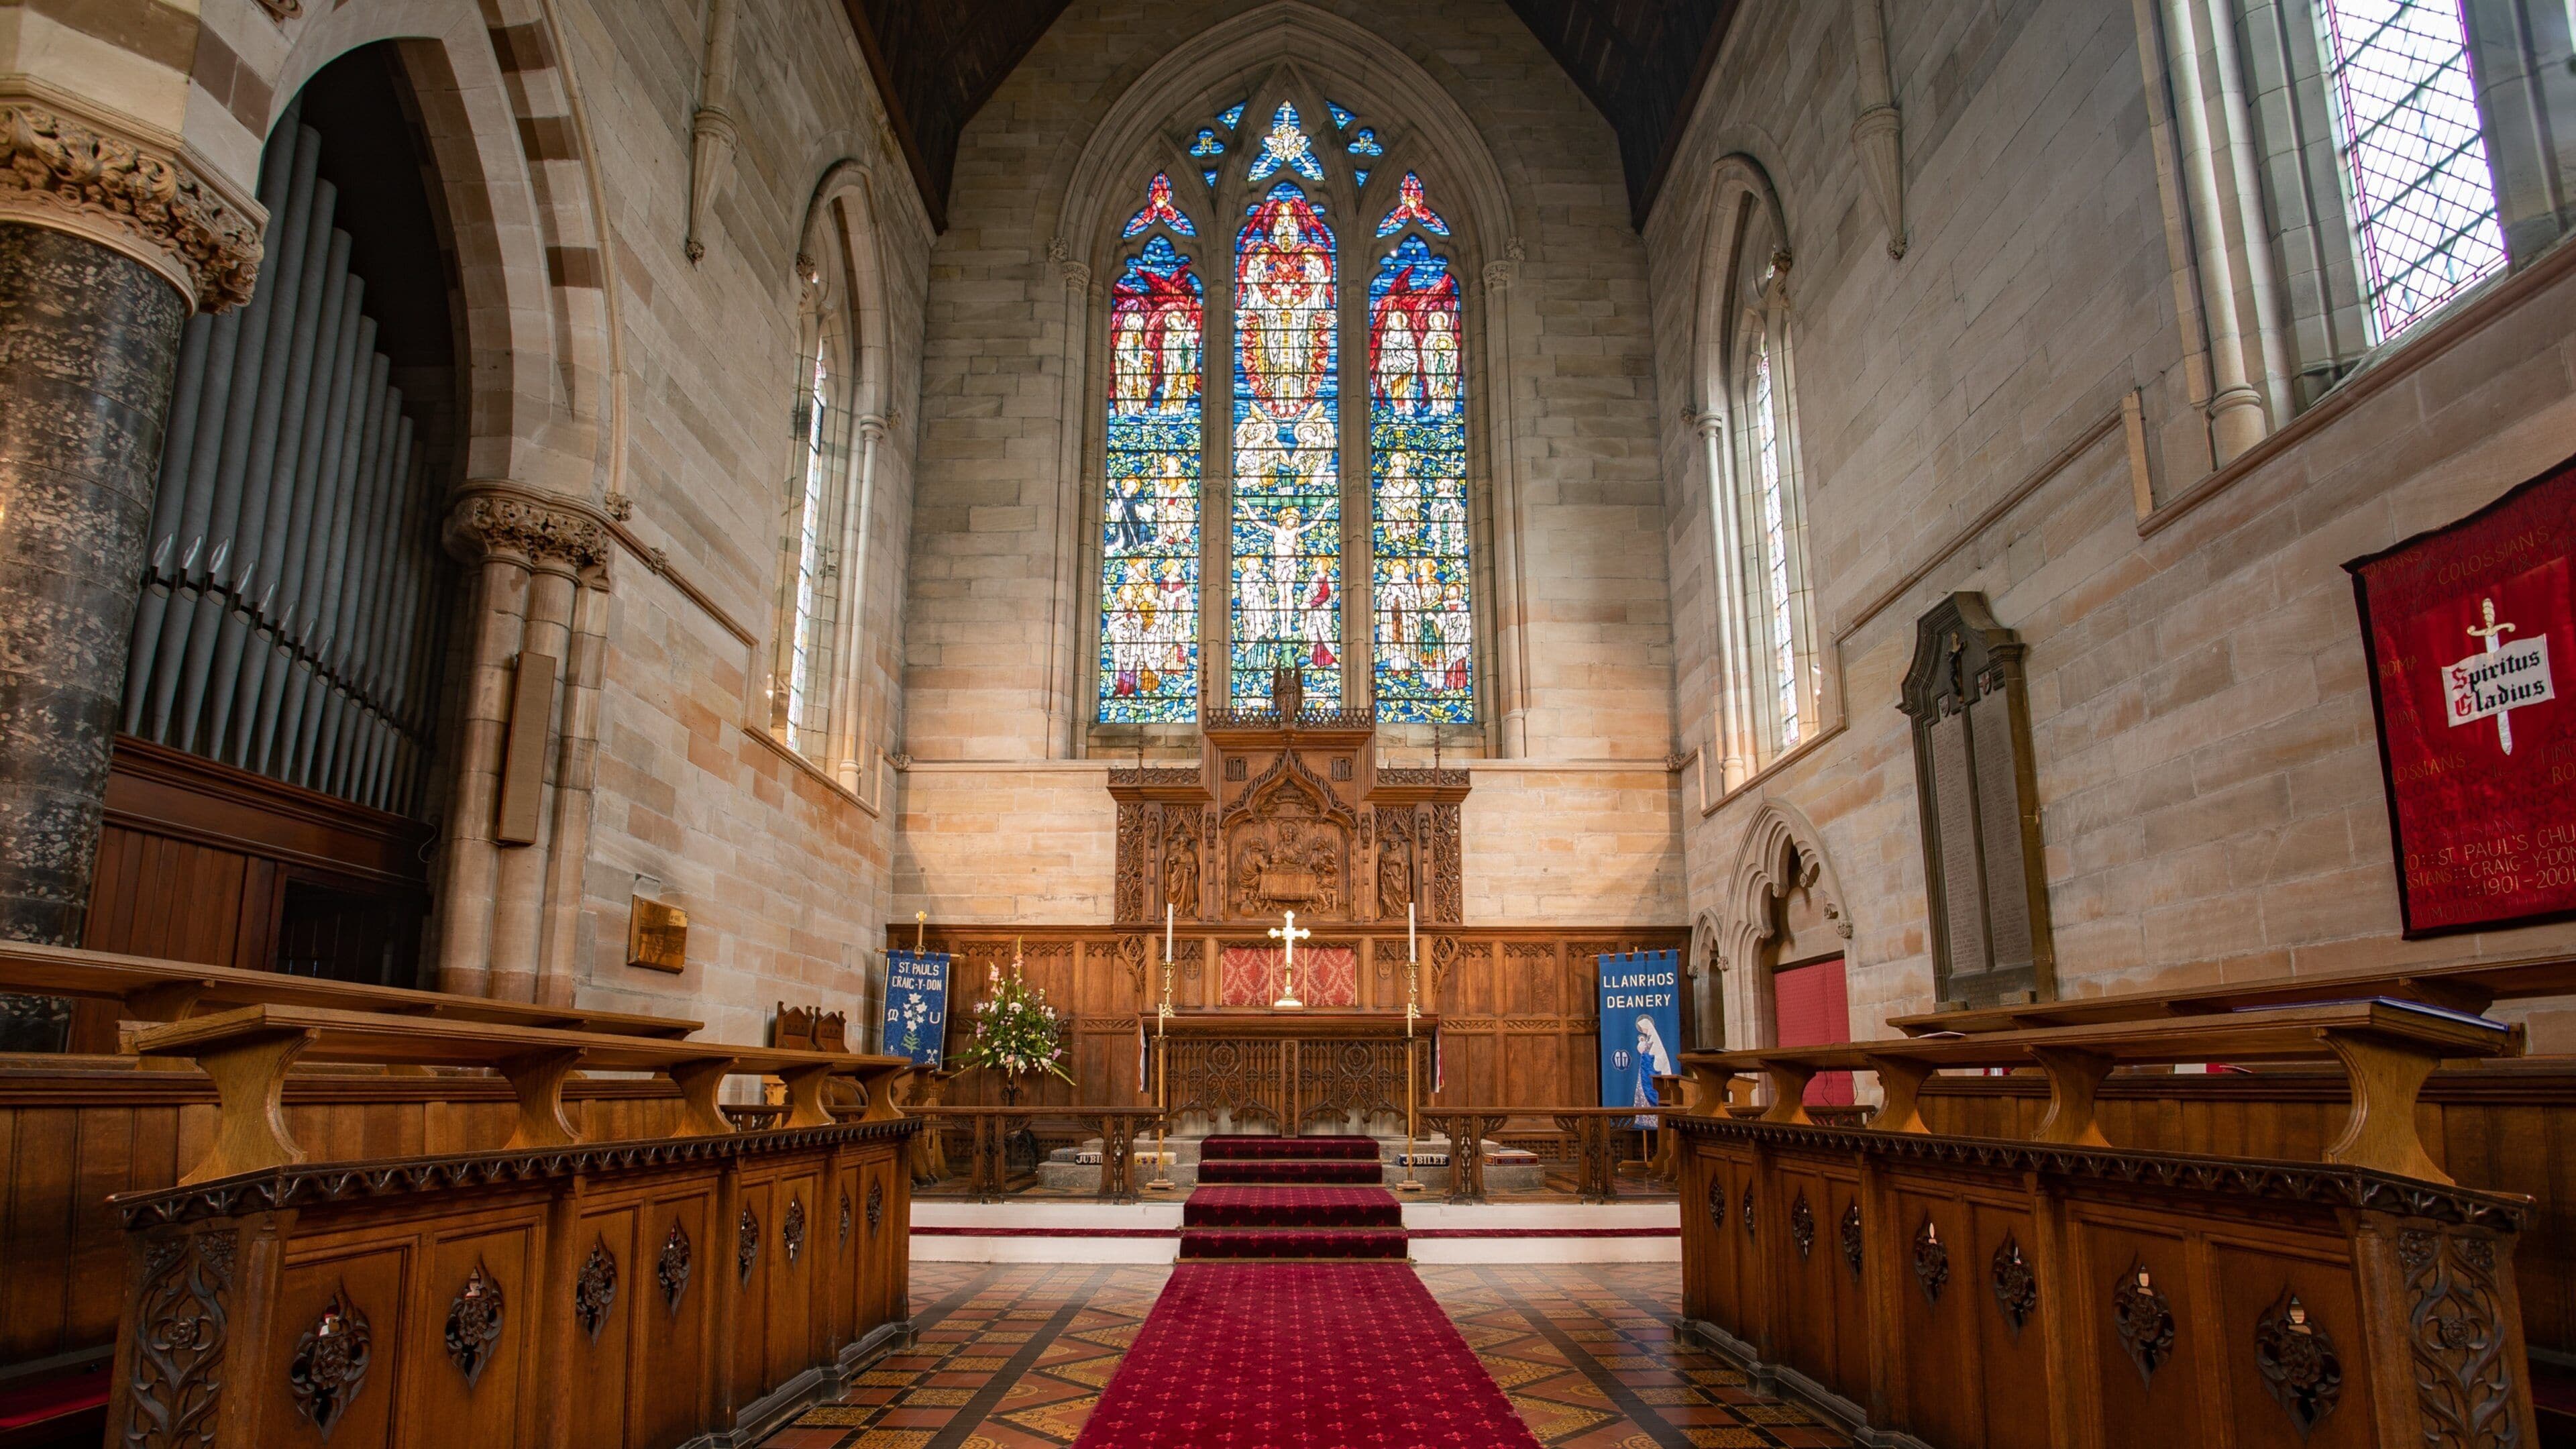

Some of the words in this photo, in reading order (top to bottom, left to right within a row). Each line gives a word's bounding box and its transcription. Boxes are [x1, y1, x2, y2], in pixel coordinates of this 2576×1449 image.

[2438, 525, 2550, 586] COLOSSIANS
[2451, 650, 2541, 694] Spiritus
[2455, 679, 2545, 717] Gladius
[2438, 847, 2456, 866] ST
[2463, 834, 2529, 861] PAUL'S
[1603, 972, 1674, 988] LLANRHOS
[1607, 994, 1671, 1009] DEANERY
